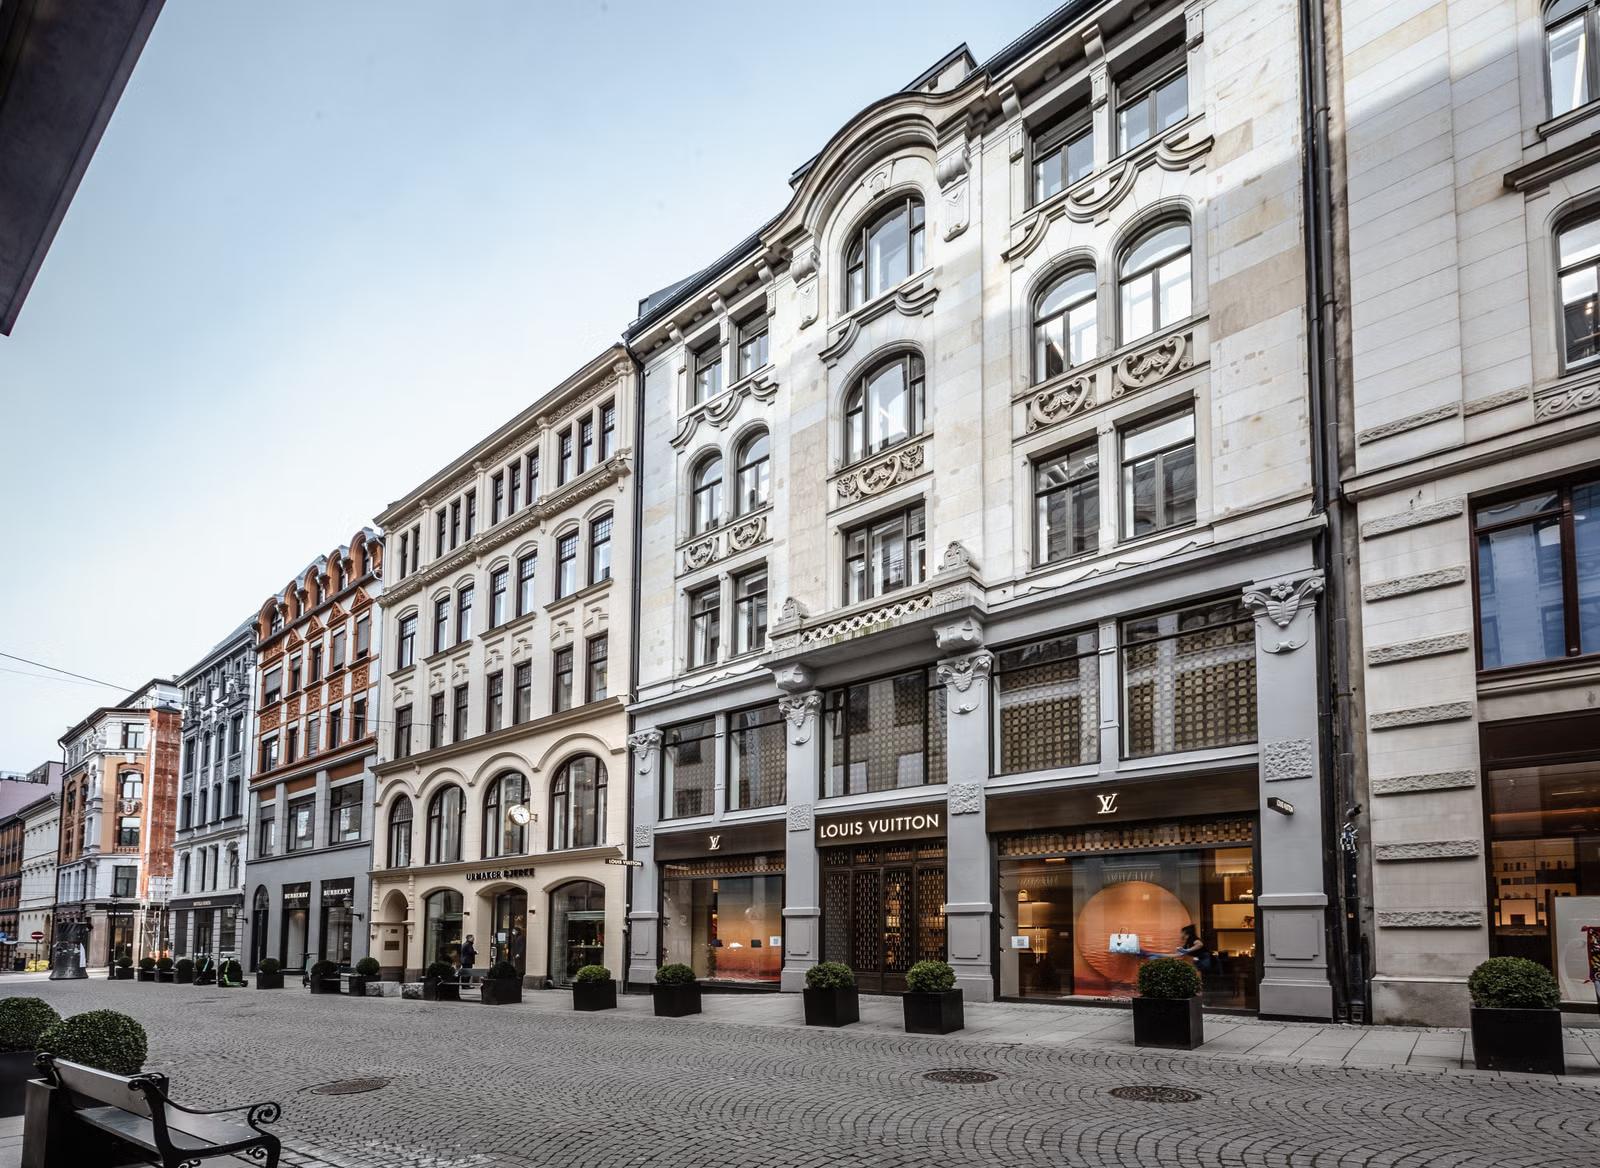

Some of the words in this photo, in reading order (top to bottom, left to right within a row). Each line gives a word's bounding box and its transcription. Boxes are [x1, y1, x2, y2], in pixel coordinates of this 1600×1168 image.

[820, 821, 863, 838] LOUIS
[868, 813, 939, 834] VUITTON
[466, 870, 502, 881] URMAKER
